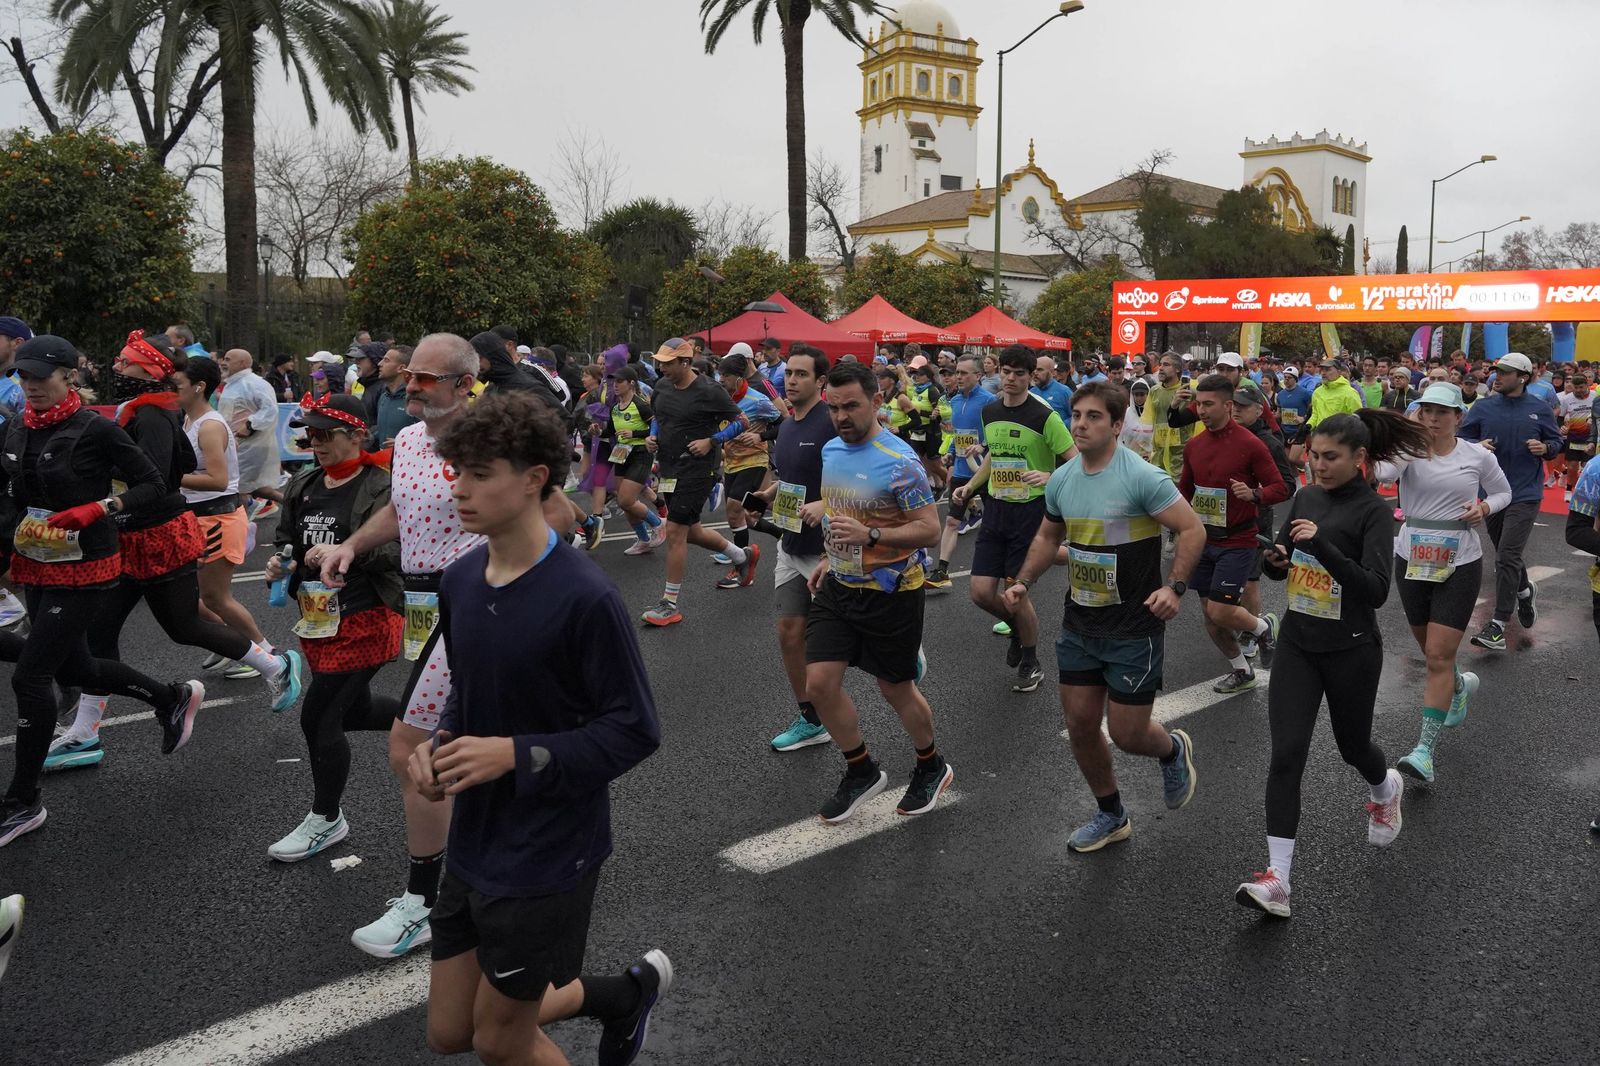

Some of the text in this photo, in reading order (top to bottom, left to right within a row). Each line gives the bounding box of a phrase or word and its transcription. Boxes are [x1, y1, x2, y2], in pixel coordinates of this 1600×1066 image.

[1378, 283, 1453, 298] maratón
[1545, 285, 1600, 303] HOKA
[1192, 296, 1229, 306] Sprinter
[1231, 302, 1262, 310] HYUNDAI
[1268, 292, 1312, 308] HOKA
[1396, 294, 1455, 311] sevilla
[992, 470, 1020, 483] 18806
[1195, 495, 1217, 510] 8640
[324, 516, 336, 526] up
[303, 530, 335, 546] run
[1411, 544, 1450, 561] 19814
[1291, 564, 1332, 593] 17623
